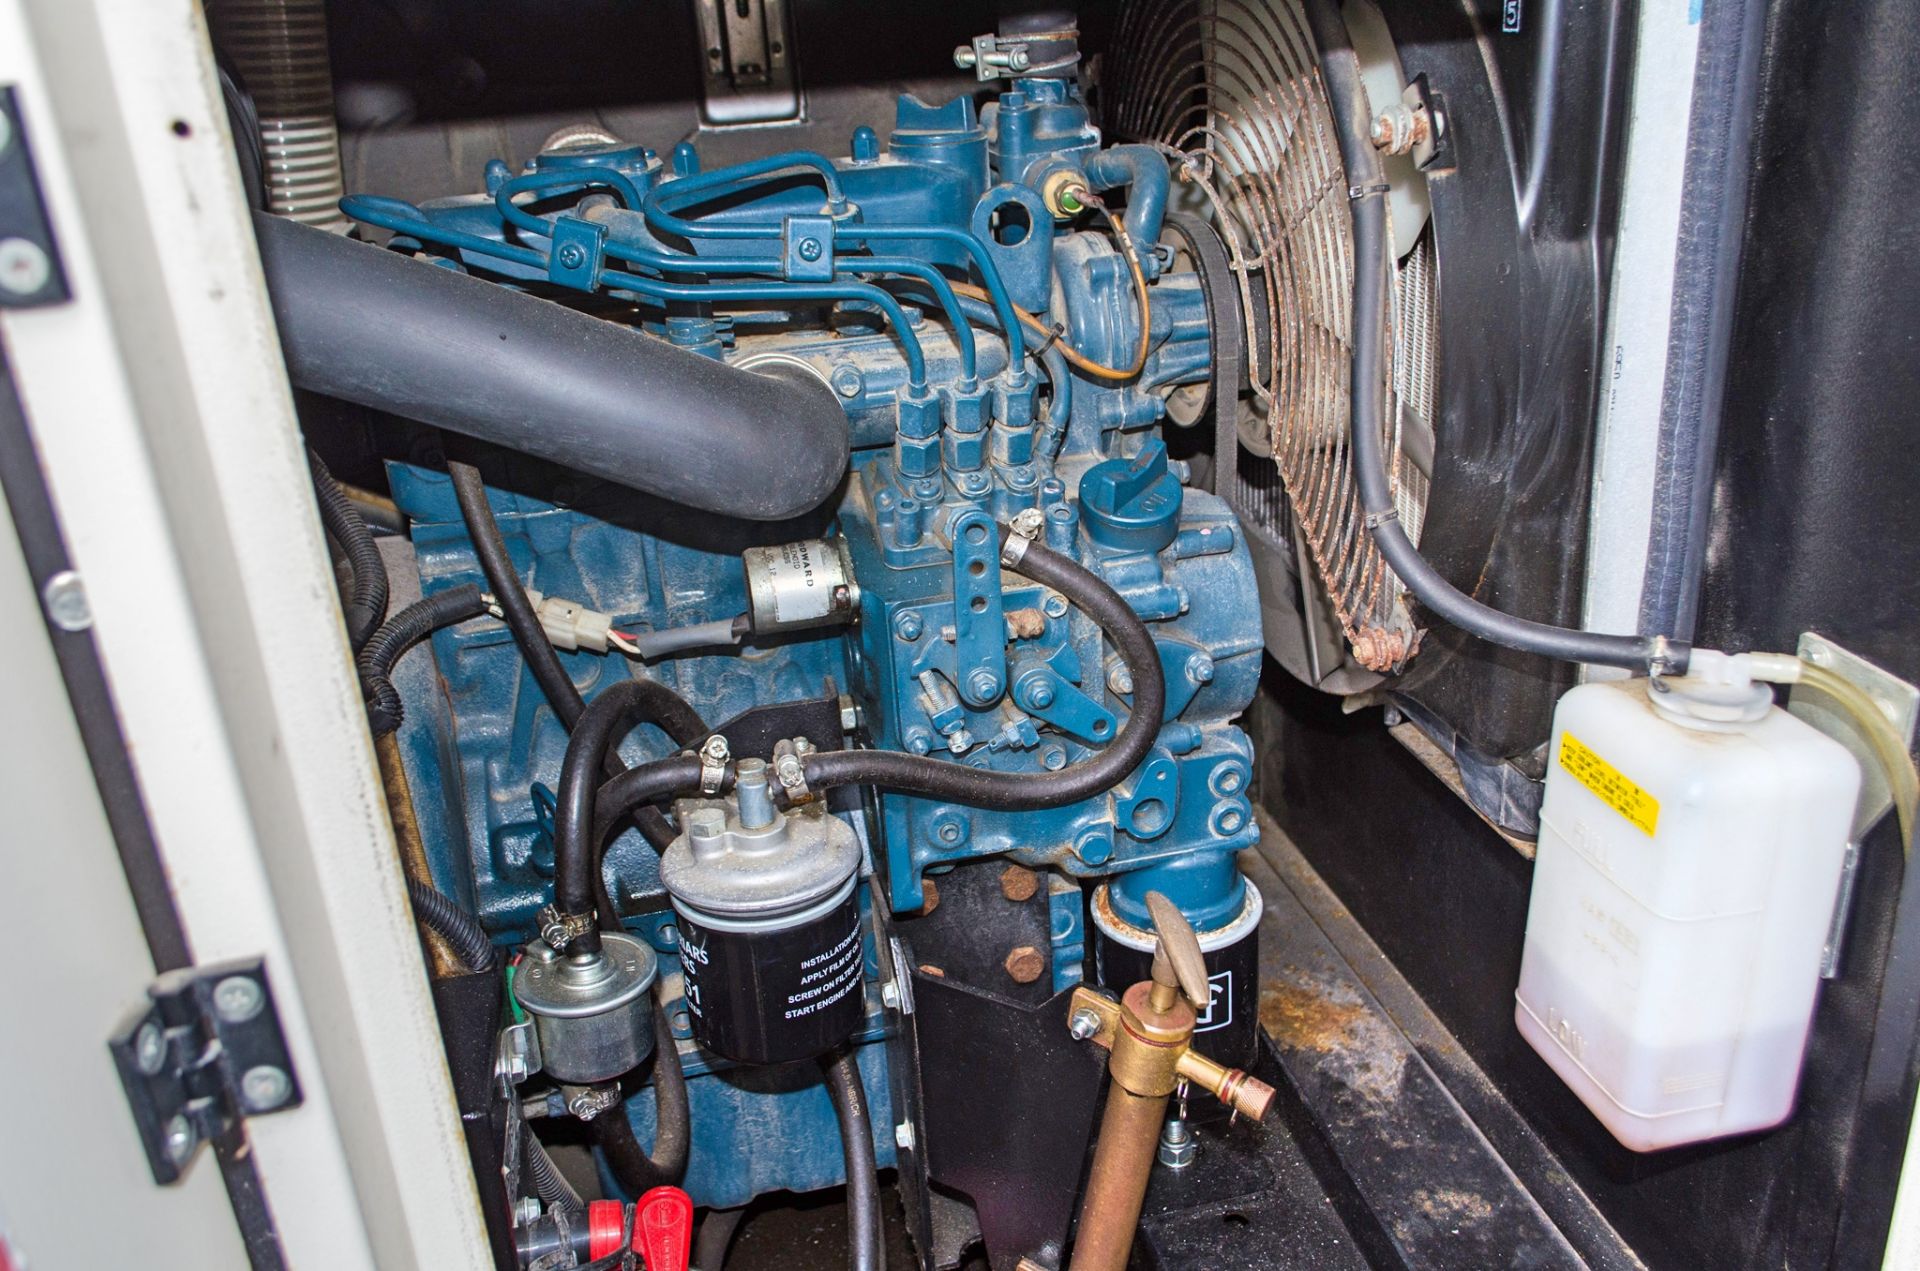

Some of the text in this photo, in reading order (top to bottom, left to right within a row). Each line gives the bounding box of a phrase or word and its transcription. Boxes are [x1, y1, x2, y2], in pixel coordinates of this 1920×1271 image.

[801, 935, 852, 970] INSTALLATION
[801, 967, 828, 985] APPLY
[829, 957, 845, 973] FILM
[845, 949, 852, 961] OF
[785, 978, 857, 1019] START ENGINE AND
[788, 986, 822, 1004] SCREW
[822, 980, 835, 992] ON
[835, 964, 855, 985] FILTER
